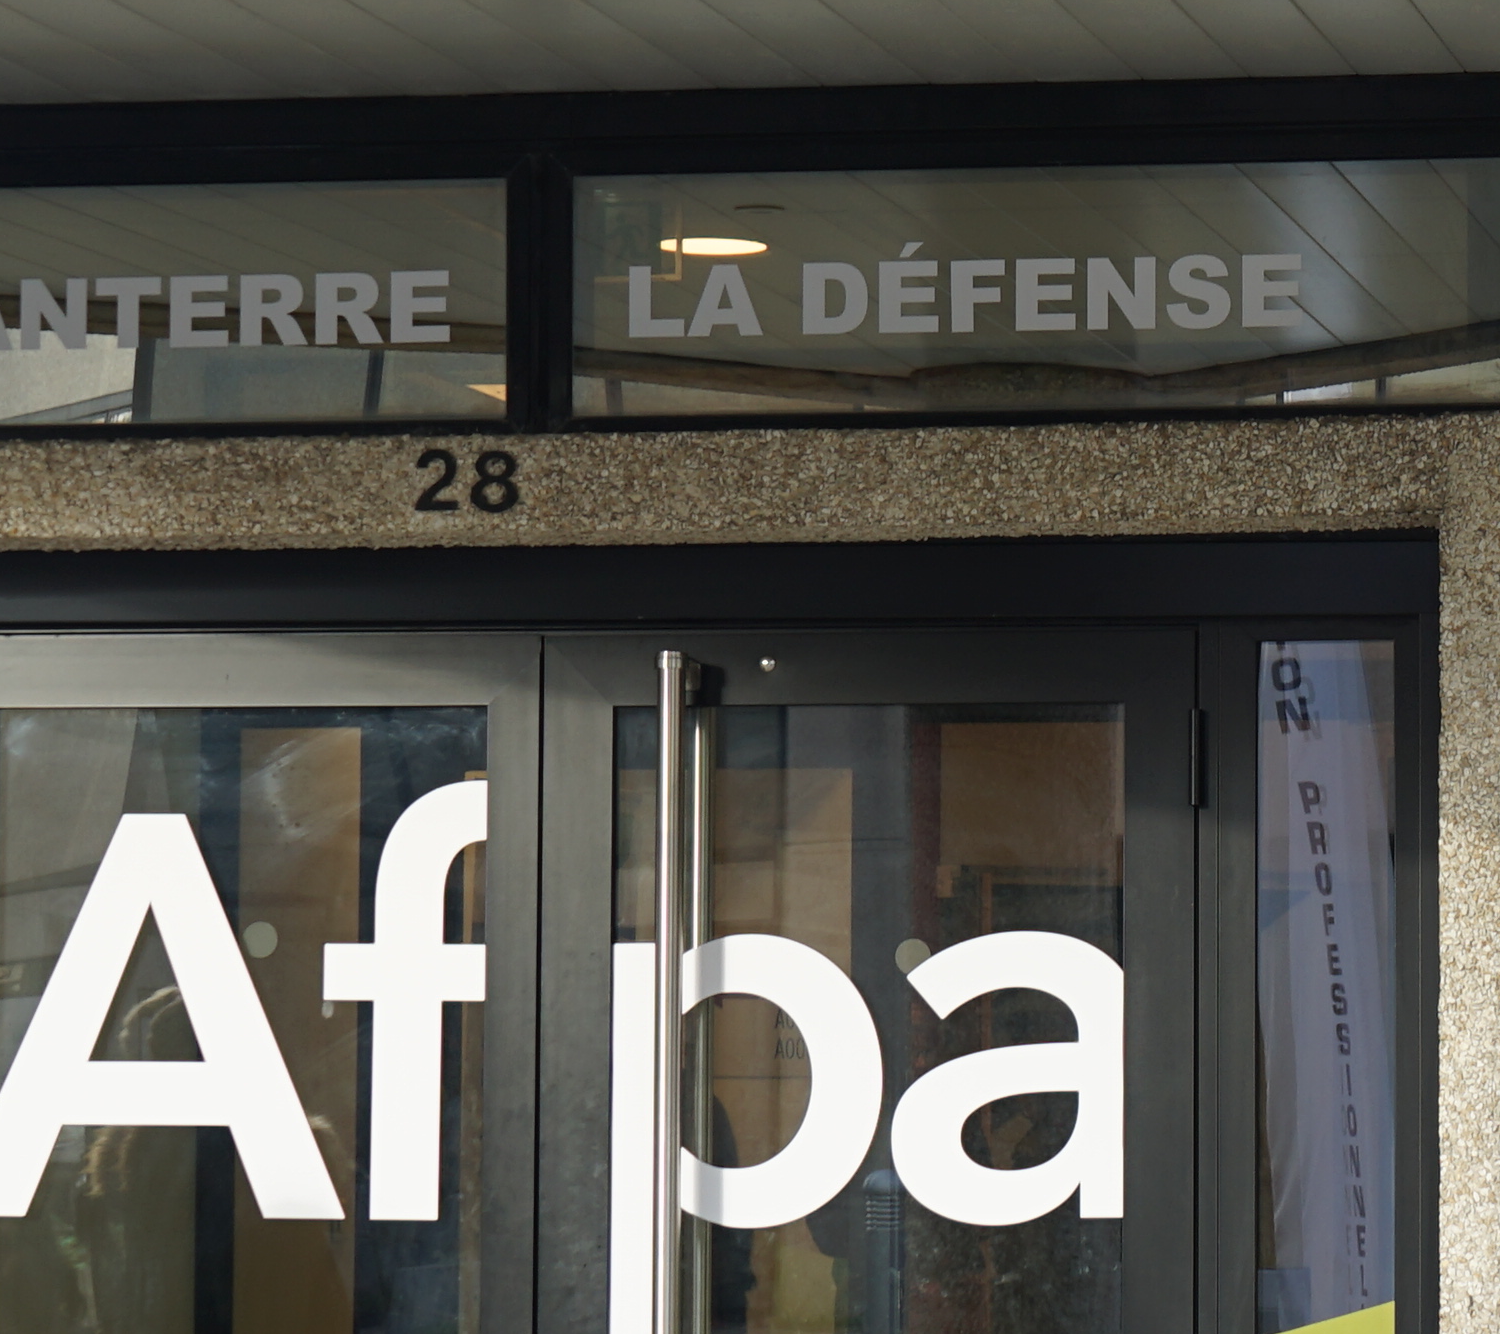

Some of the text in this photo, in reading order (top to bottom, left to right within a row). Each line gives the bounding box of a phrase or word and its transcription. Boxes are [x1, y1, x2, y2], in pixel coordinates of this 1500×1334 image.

[627, 263, 763, 338] LA
[802, 242, 1301, 335] DÉFENSE
[414, 448, 520, 514] 28
[1298, 781, 1368, 1310] PROFESSIONNEL
